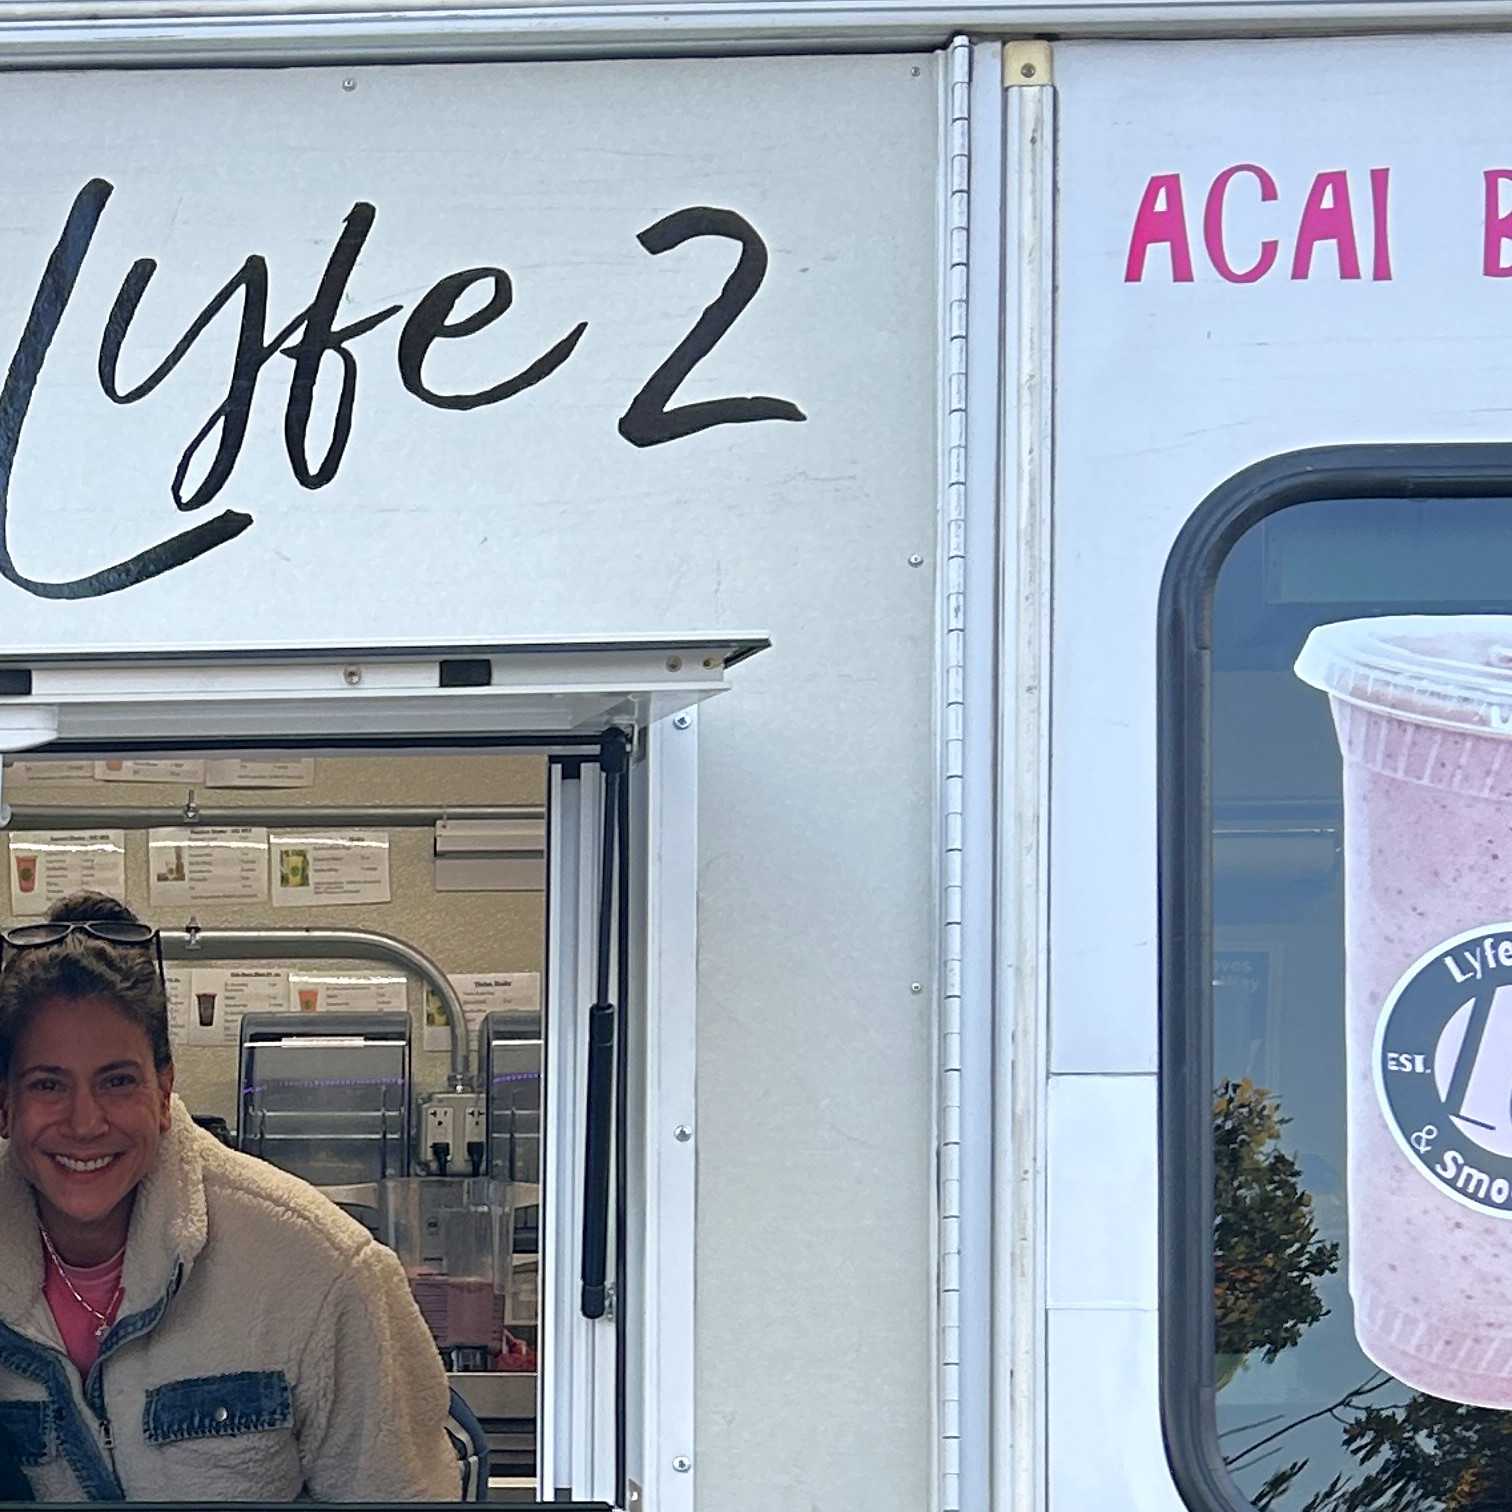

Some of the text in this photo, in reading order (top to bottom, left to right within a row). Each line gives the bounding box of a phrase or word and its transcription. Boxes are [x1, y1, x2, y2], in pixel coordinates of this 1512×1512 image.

[1124, 164, 1393, 284] ACAI
[619, 206, 806, 447] 2
[1444, 937, 1512, 983] Lyfe
[1387, 1051, 1432, 1074] EST.
[1410, 1125, 1512, 1204] & Smo
